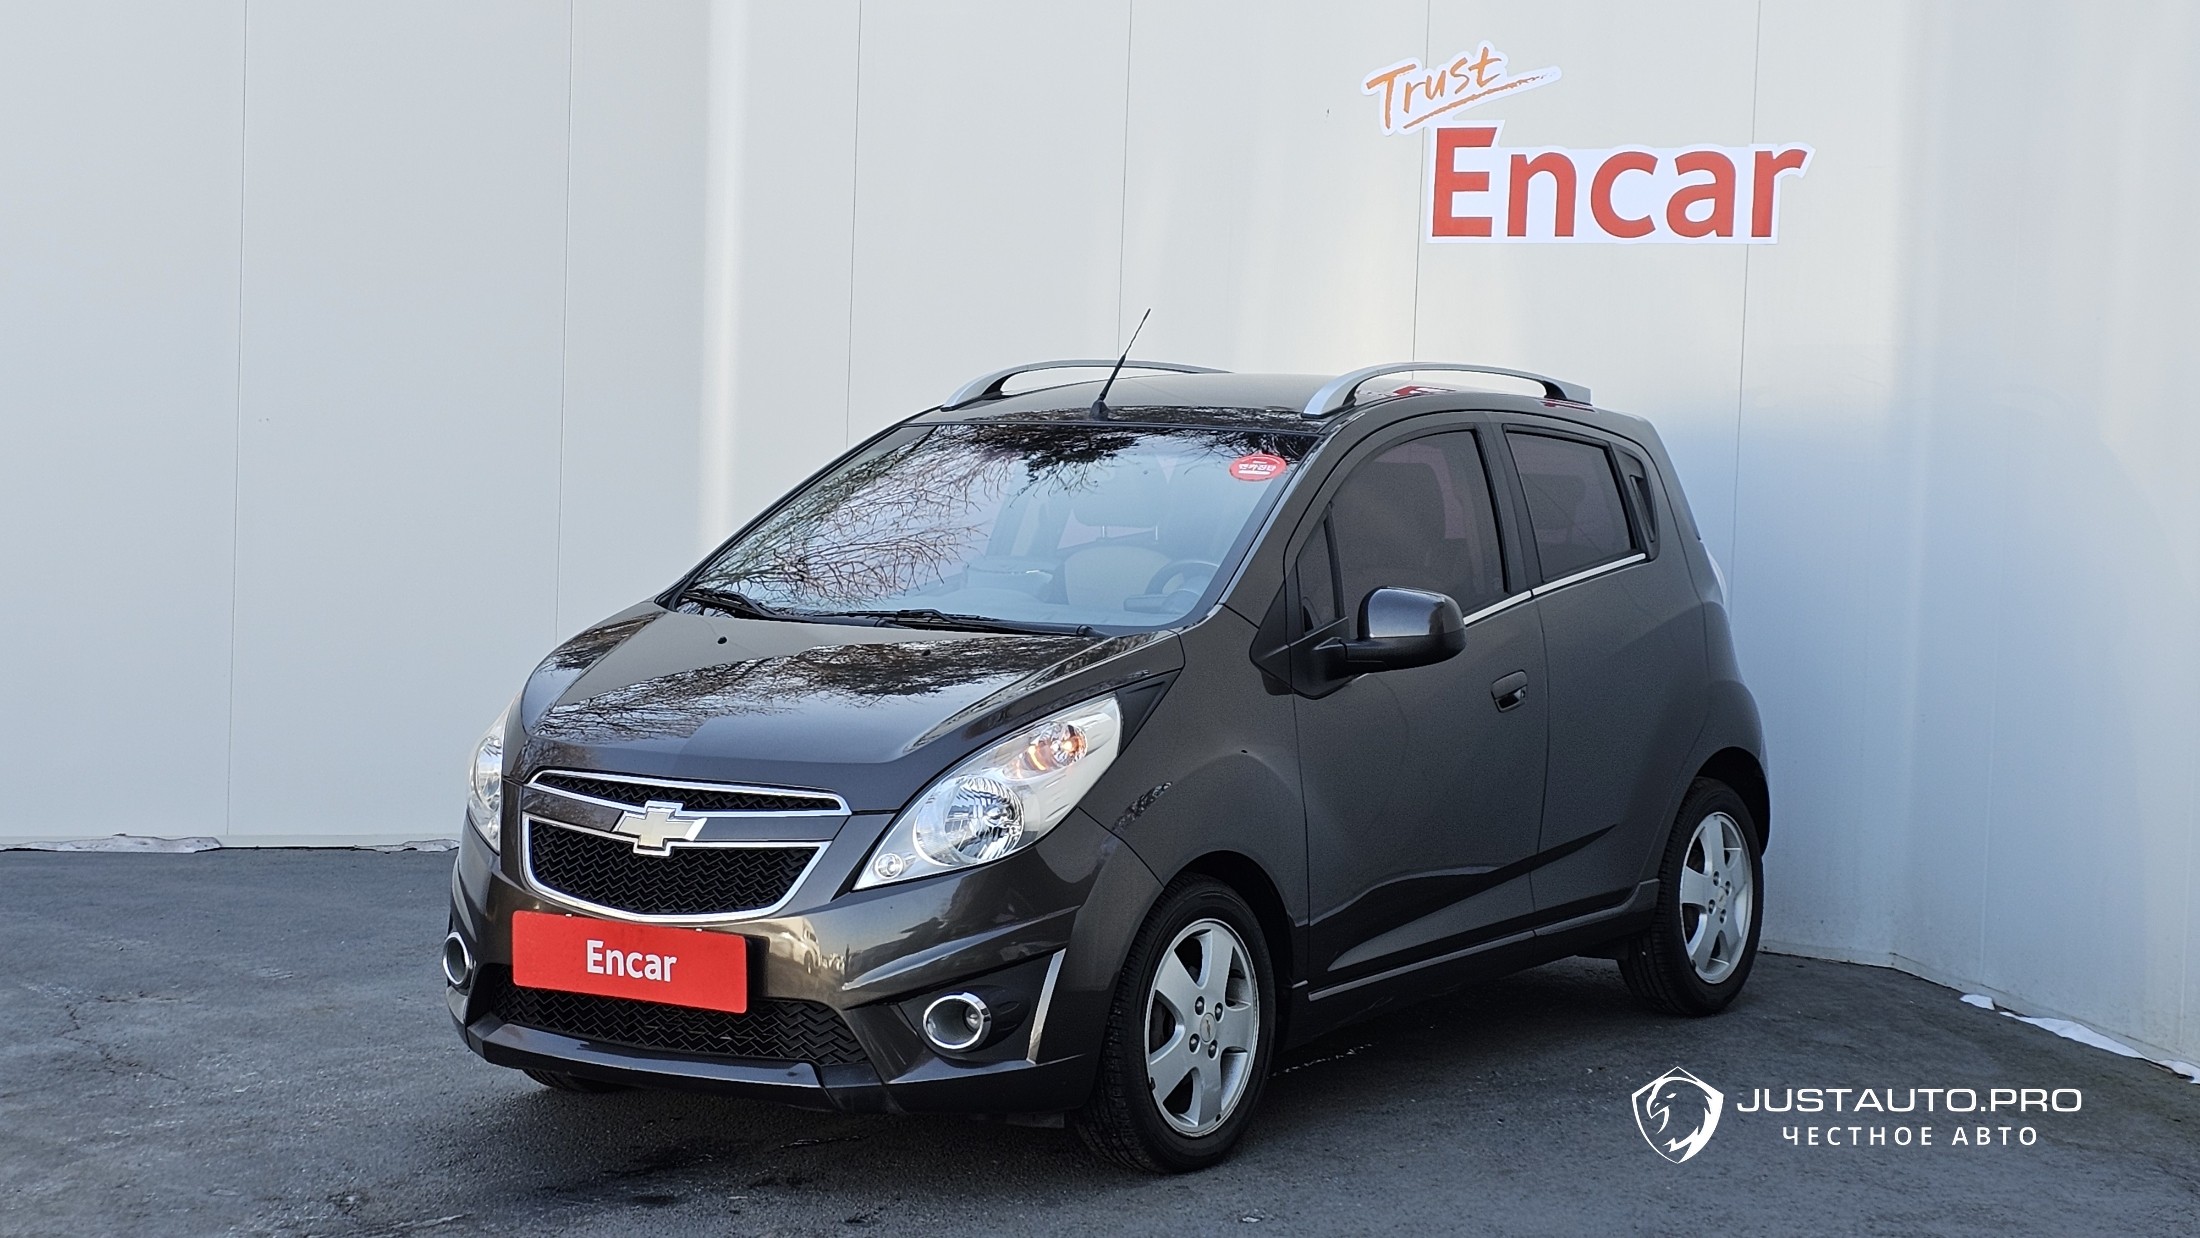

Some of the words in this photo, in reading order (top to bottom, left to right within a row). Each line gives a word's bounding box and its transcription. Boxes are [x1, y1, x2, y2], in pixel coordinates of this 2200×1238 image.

[1366, 46, 1502, 129] Trust
[1432, 127, 1807, 238] Encar
[586, 939, 677, 982] Encar
